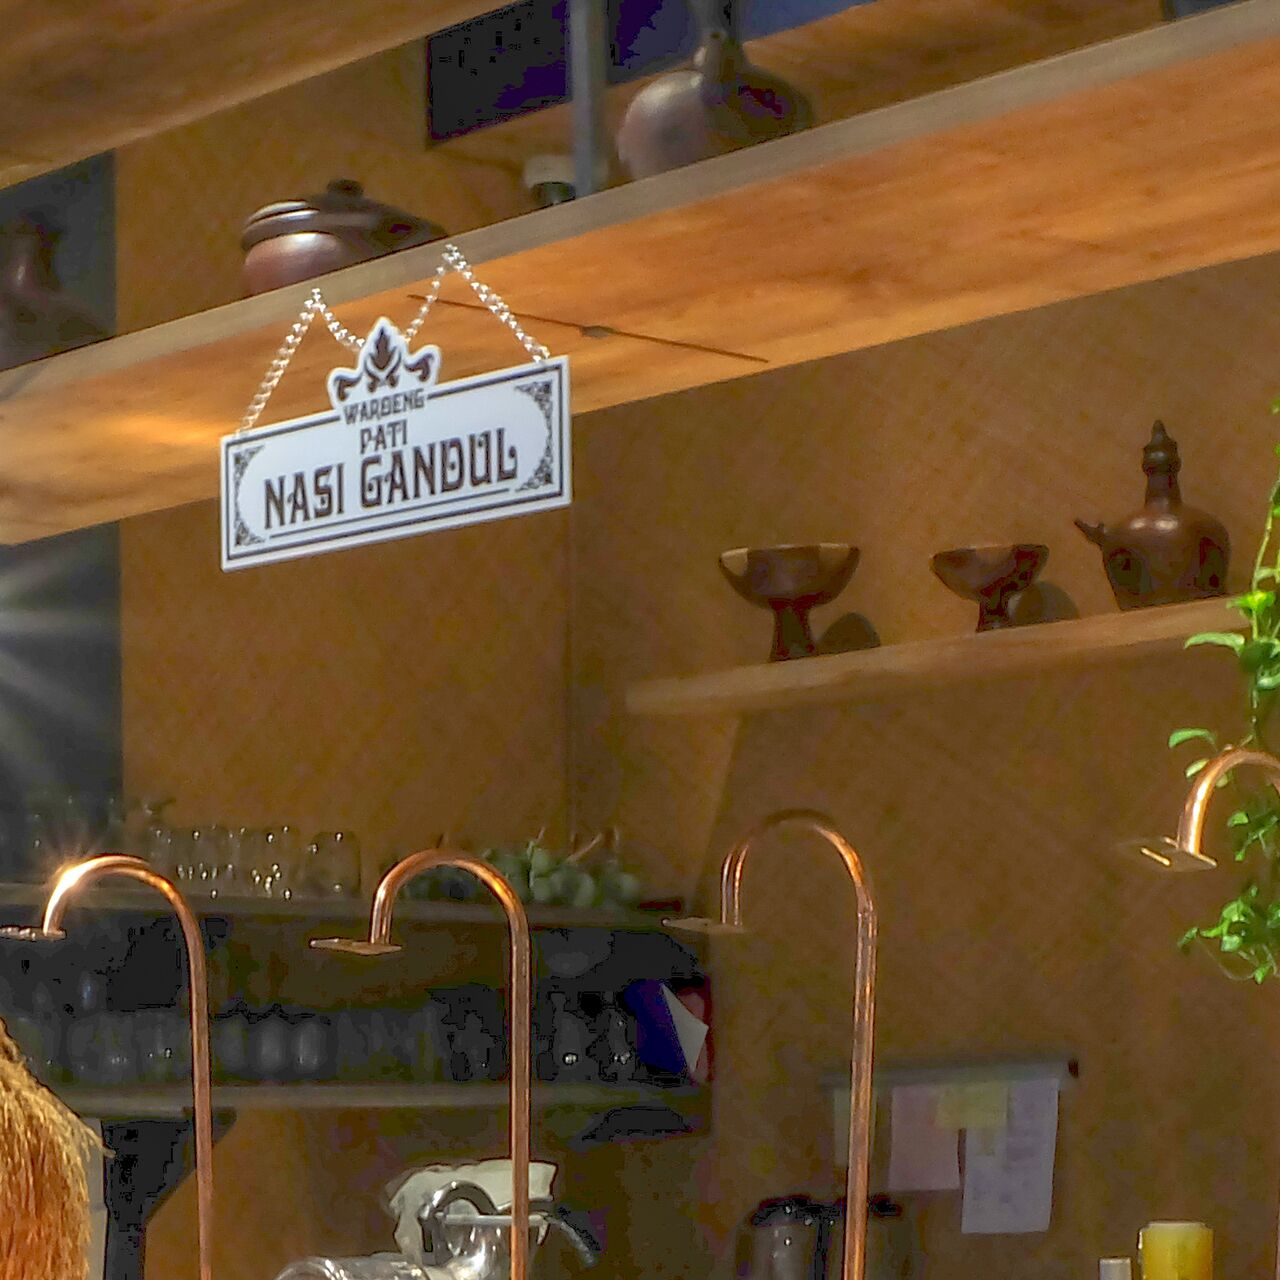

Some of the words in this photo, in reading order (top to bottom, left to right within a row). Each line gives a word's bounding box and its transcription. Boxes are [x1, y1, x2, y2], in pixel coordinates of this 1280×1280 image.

[343, 388, 425, 425] WAROENG
[359, 419, 408, 455] PATI
[263, 462, 345, 530] NASI
[360, 427, 518, 508] GANDUL
